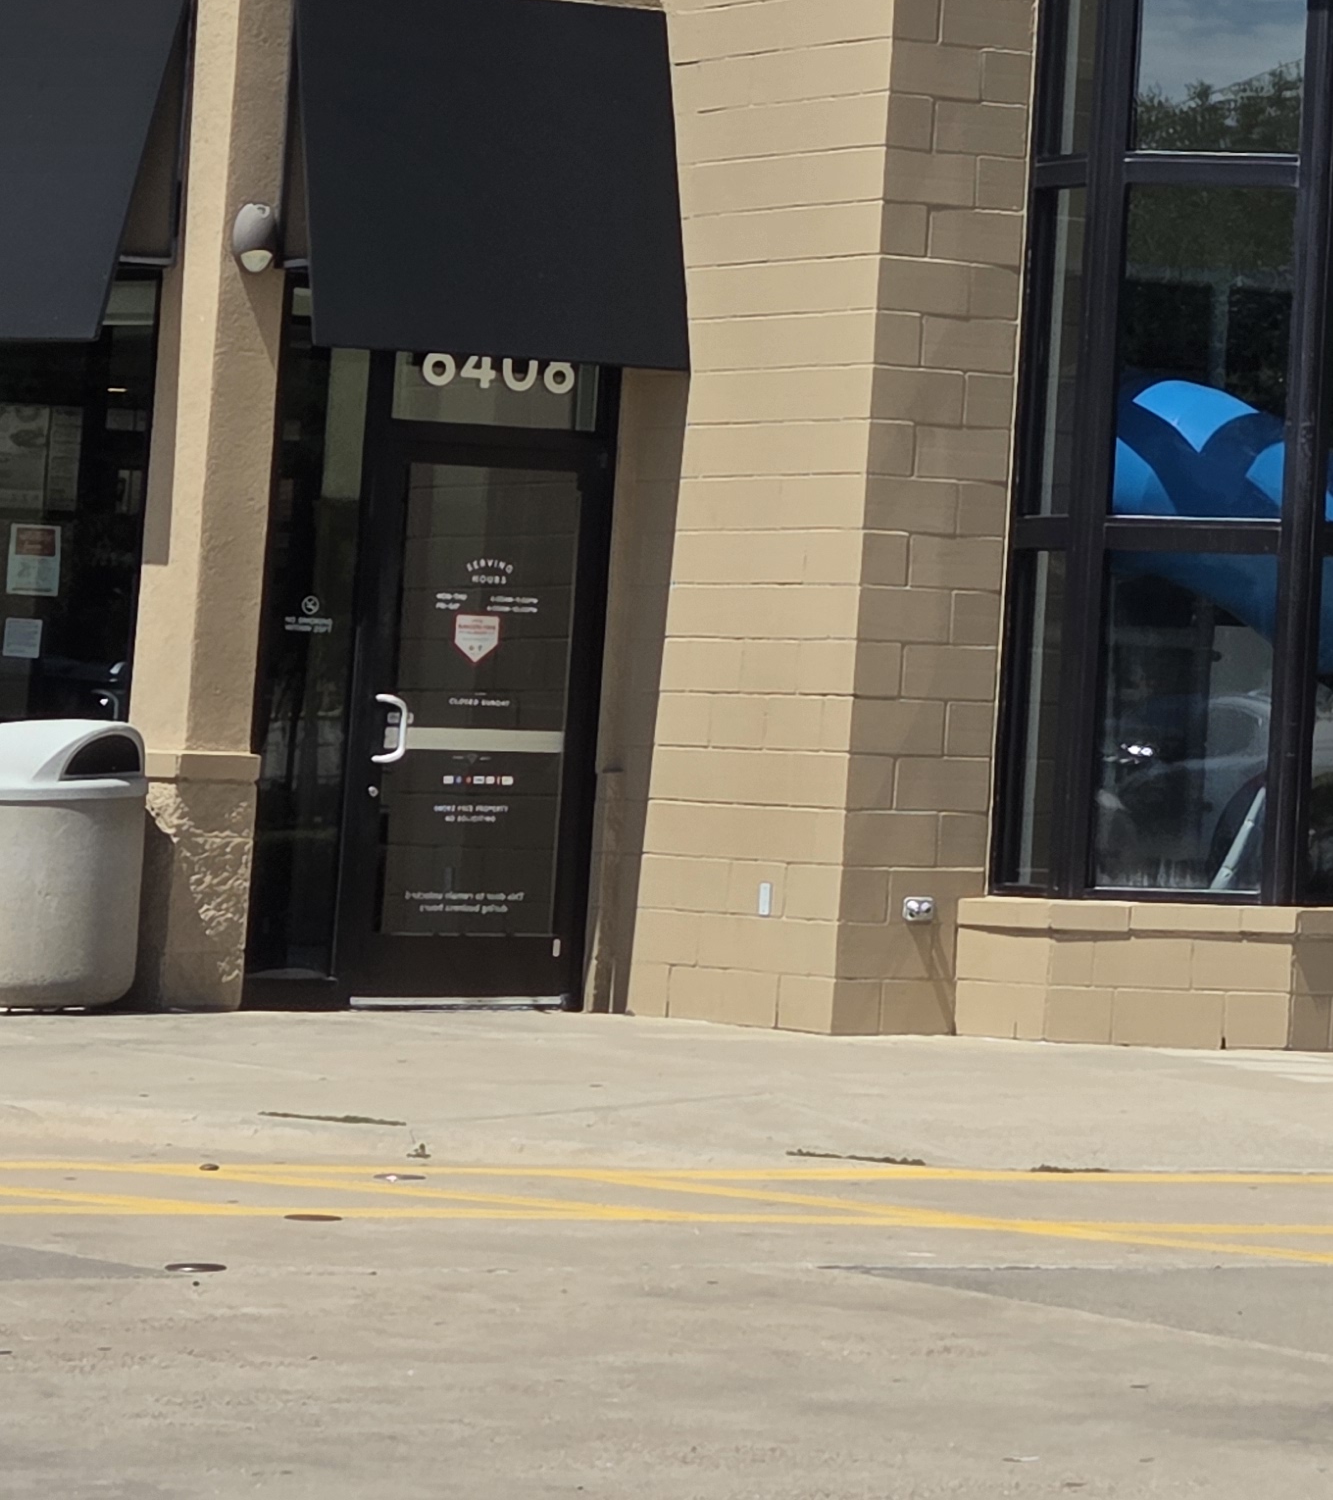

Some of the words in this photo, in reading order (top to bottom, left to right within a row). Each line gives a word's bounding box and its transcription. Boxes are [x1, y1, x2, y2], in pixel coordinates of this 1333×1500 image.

[466, 558, 514, 574] SERVING
[471, 574, 507, 584] HOURS
[448, 697, 480, 706] CLOSED
